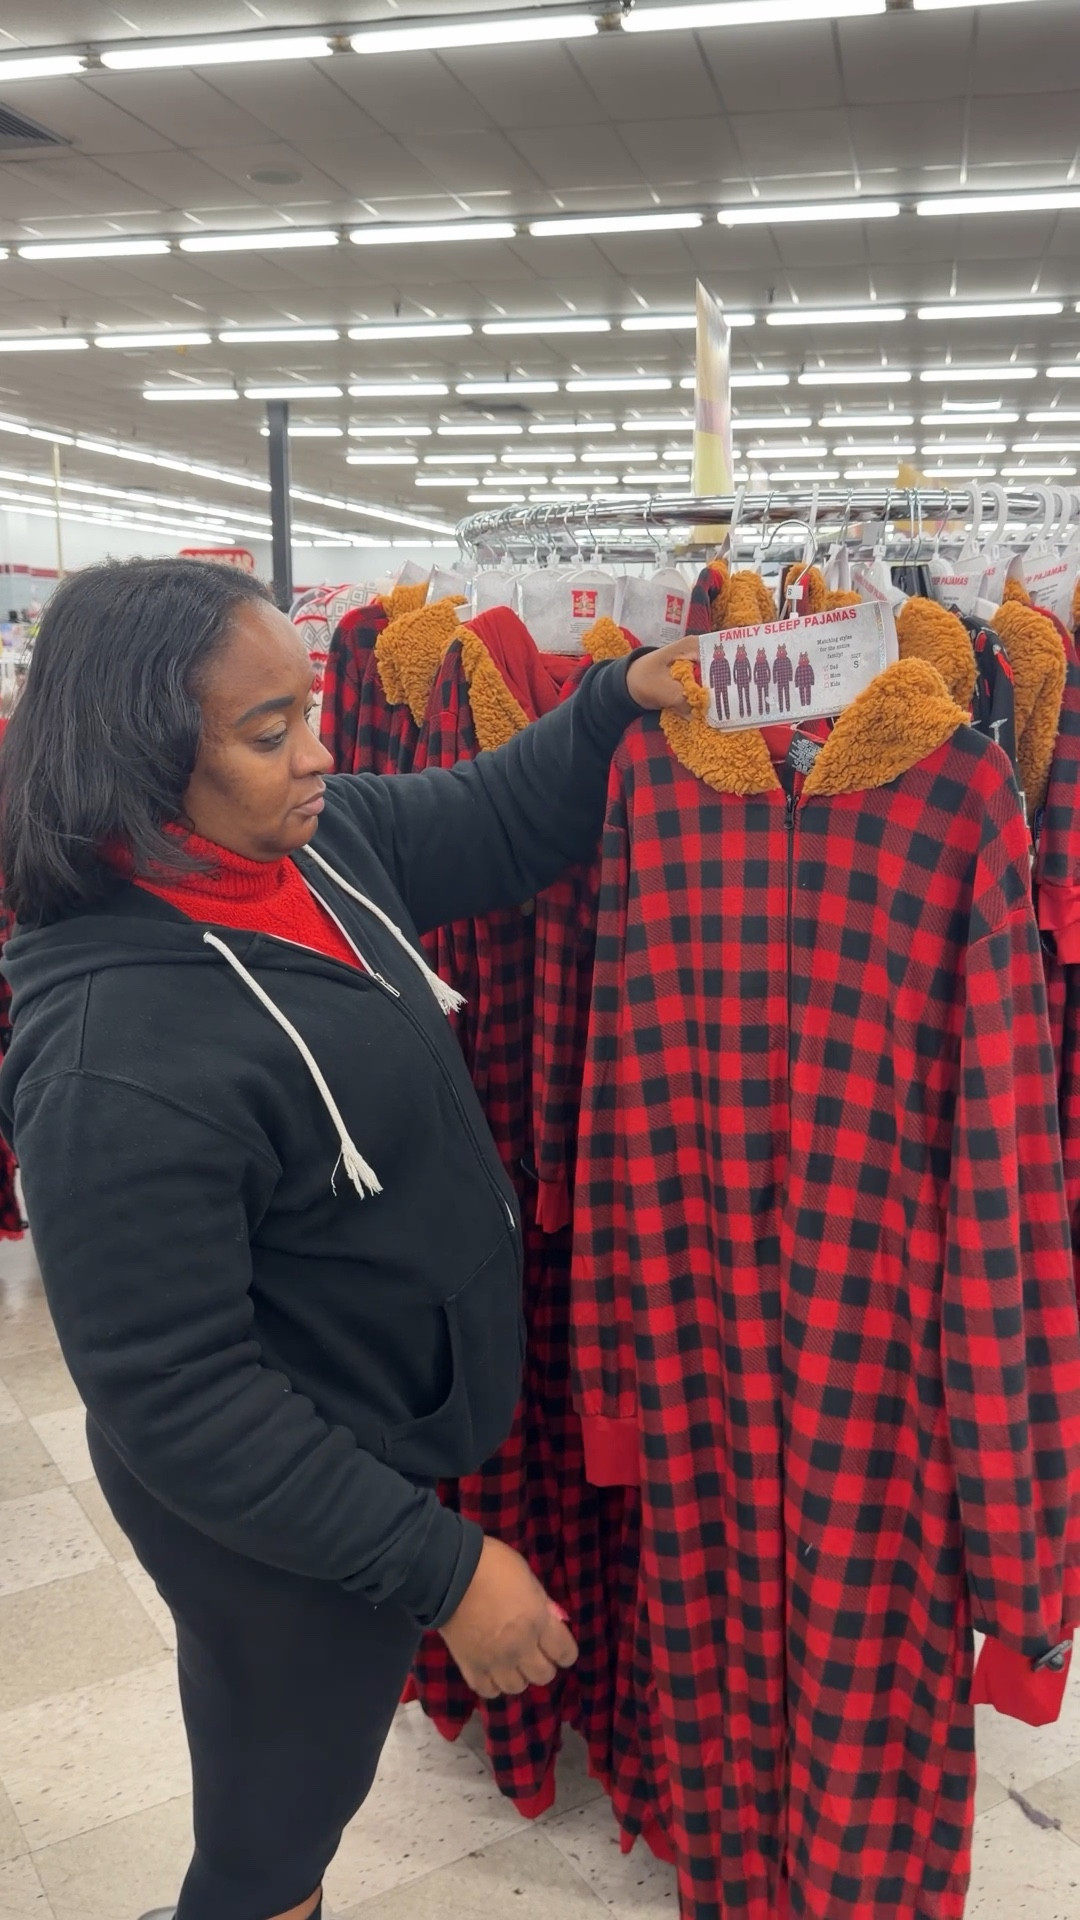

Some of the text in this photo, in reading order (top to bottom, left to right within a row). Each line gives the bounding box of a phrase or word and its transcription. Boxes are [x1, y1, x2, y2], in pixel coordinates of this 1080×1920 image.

[719, 608, 857, 642] FAMILY SLEEP PAJAMAS
[817, 634, 852, 645] Matching styles
[853, 660, 859, 669] S
